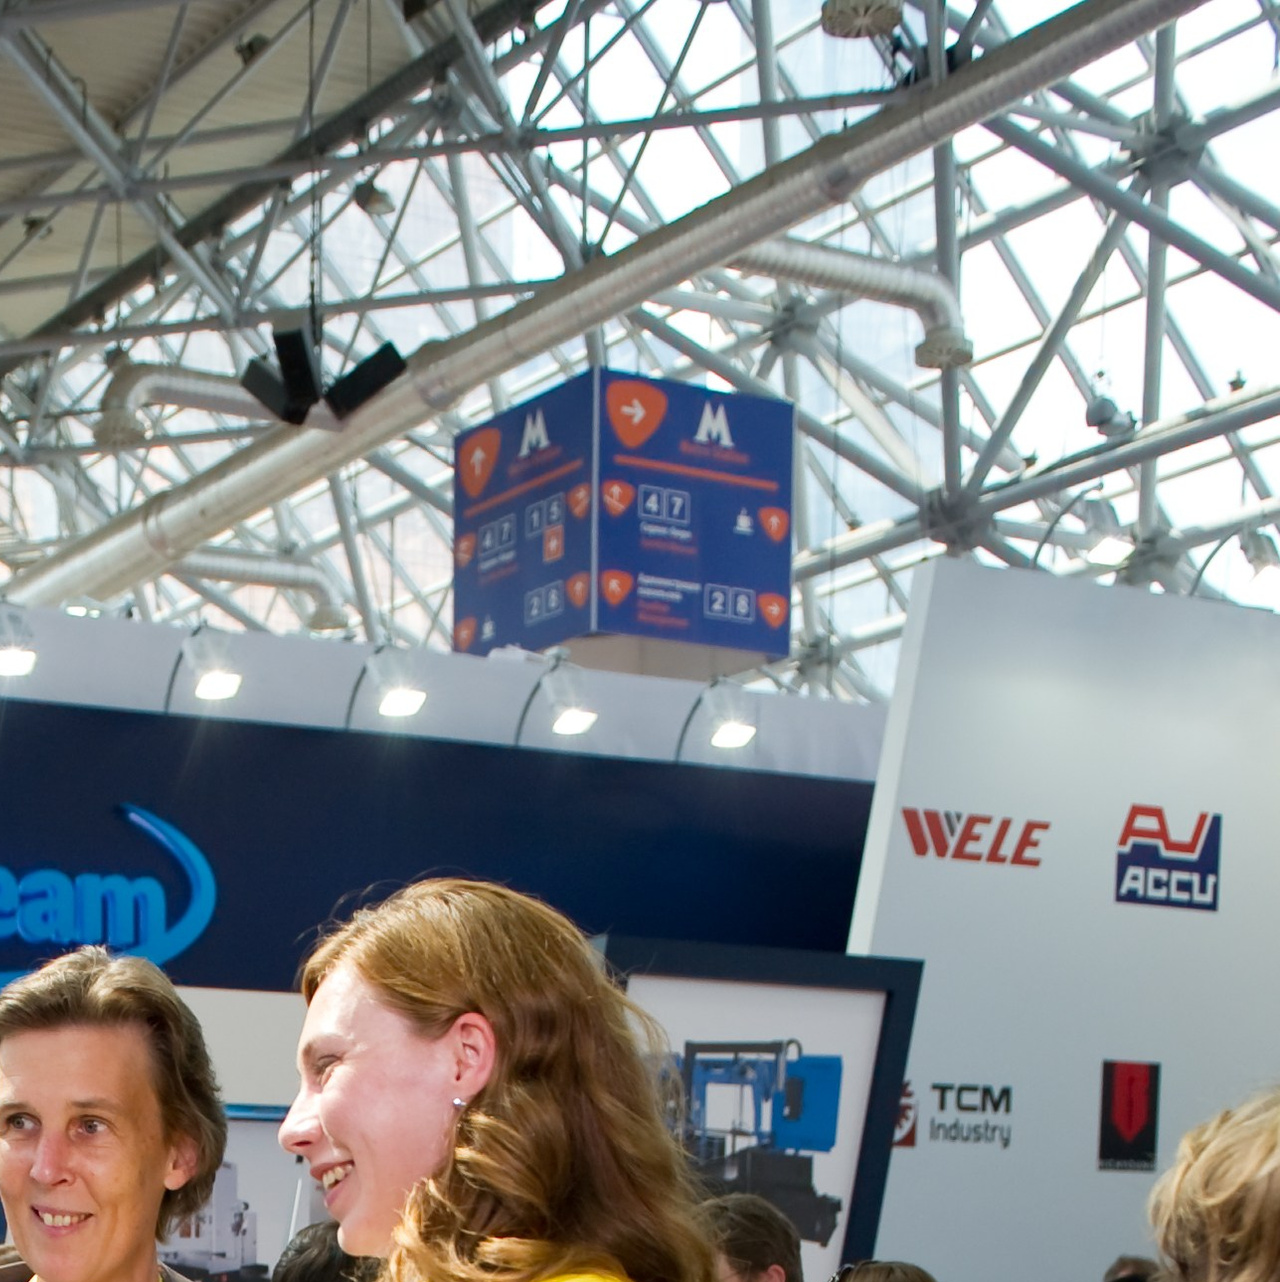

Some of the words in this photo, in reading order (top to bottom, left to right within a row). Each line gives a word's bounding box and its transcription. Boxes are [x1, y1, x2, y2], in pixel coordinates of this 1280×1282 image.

[901, 807, 1051, 868] WELE
[1119, 866, 1217, 904] ACCU
[931, 1082, 1012, 1114] TCM
[929, 1118, 1012, 1150] Industry
